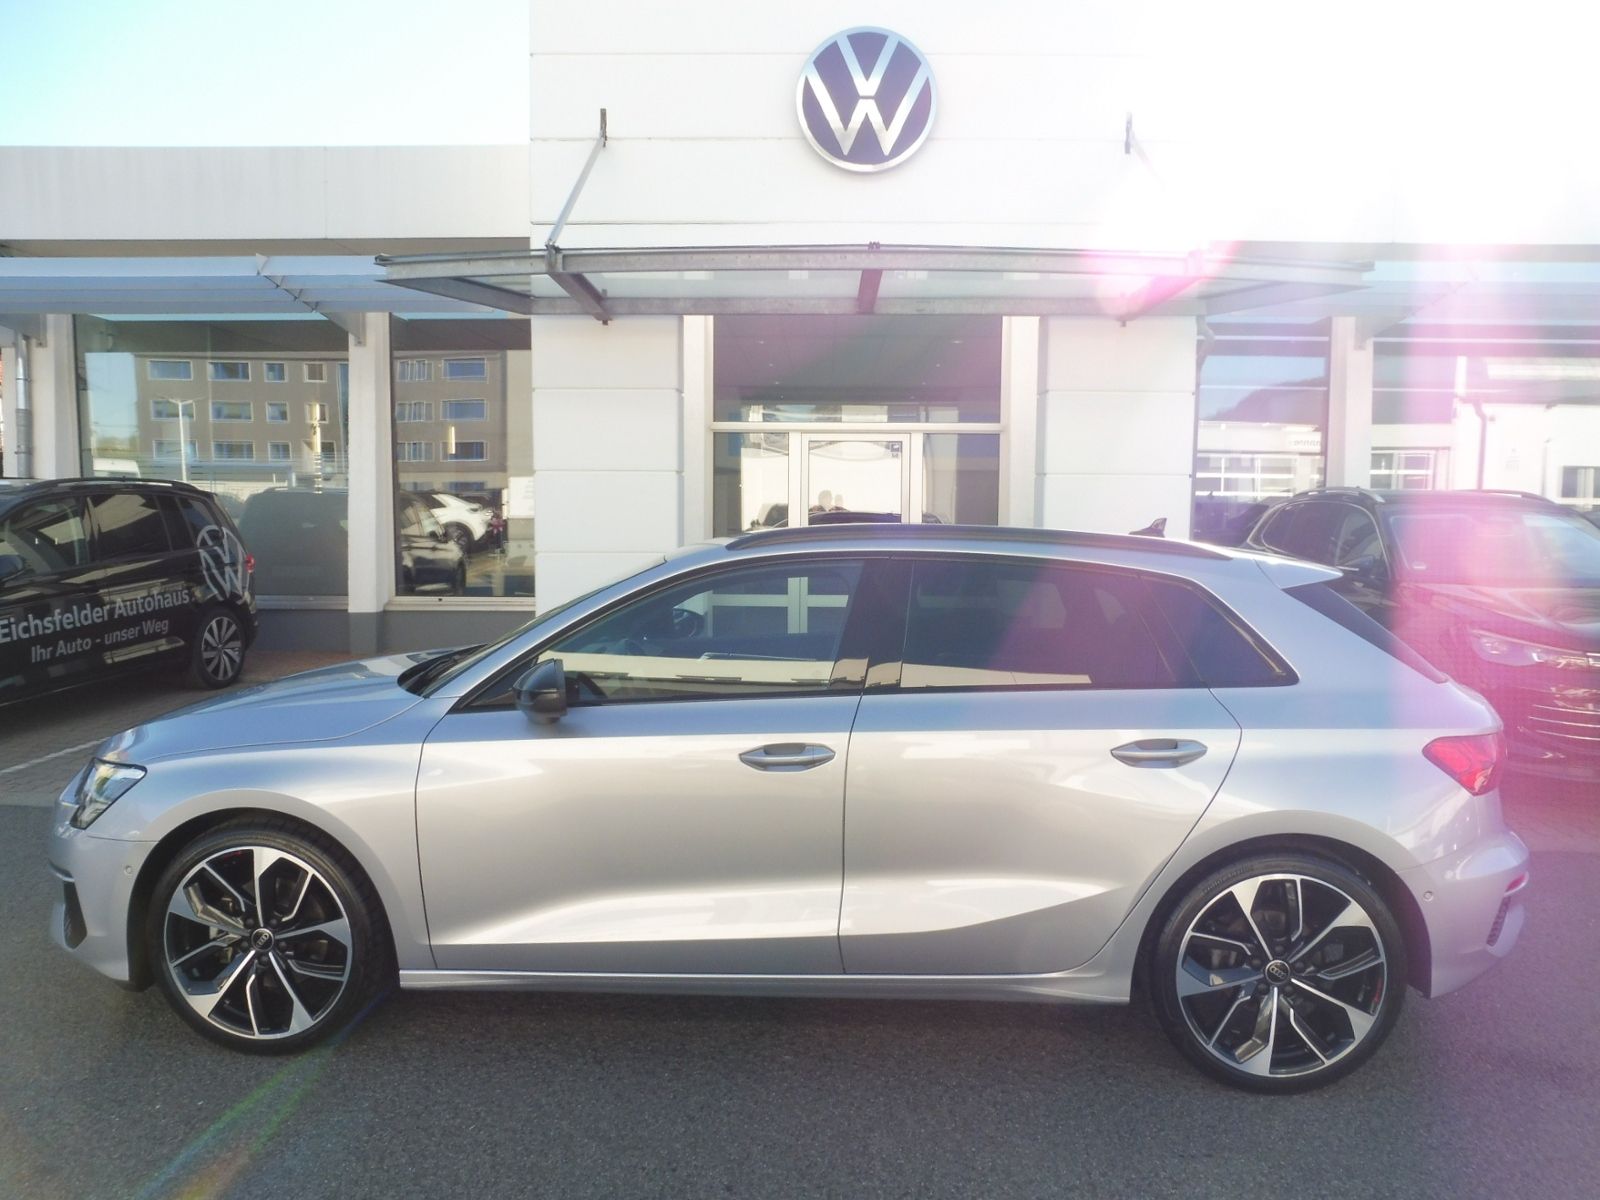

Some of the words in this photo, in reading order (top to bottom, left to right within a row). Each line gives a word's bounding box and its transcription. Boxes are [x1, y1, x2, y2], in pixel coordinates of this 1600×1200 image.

[796, 26, 937, 173] VW
[0, 603, 110, 644] Eichsfelder
[114, 589, 190, 619] Autohaus
[31, 644, 53, 663] Ihr
[55, 638, 92, 657] Auto
[104, 626, 140, 645] unser
[142, 619, 169, 635] Weg
